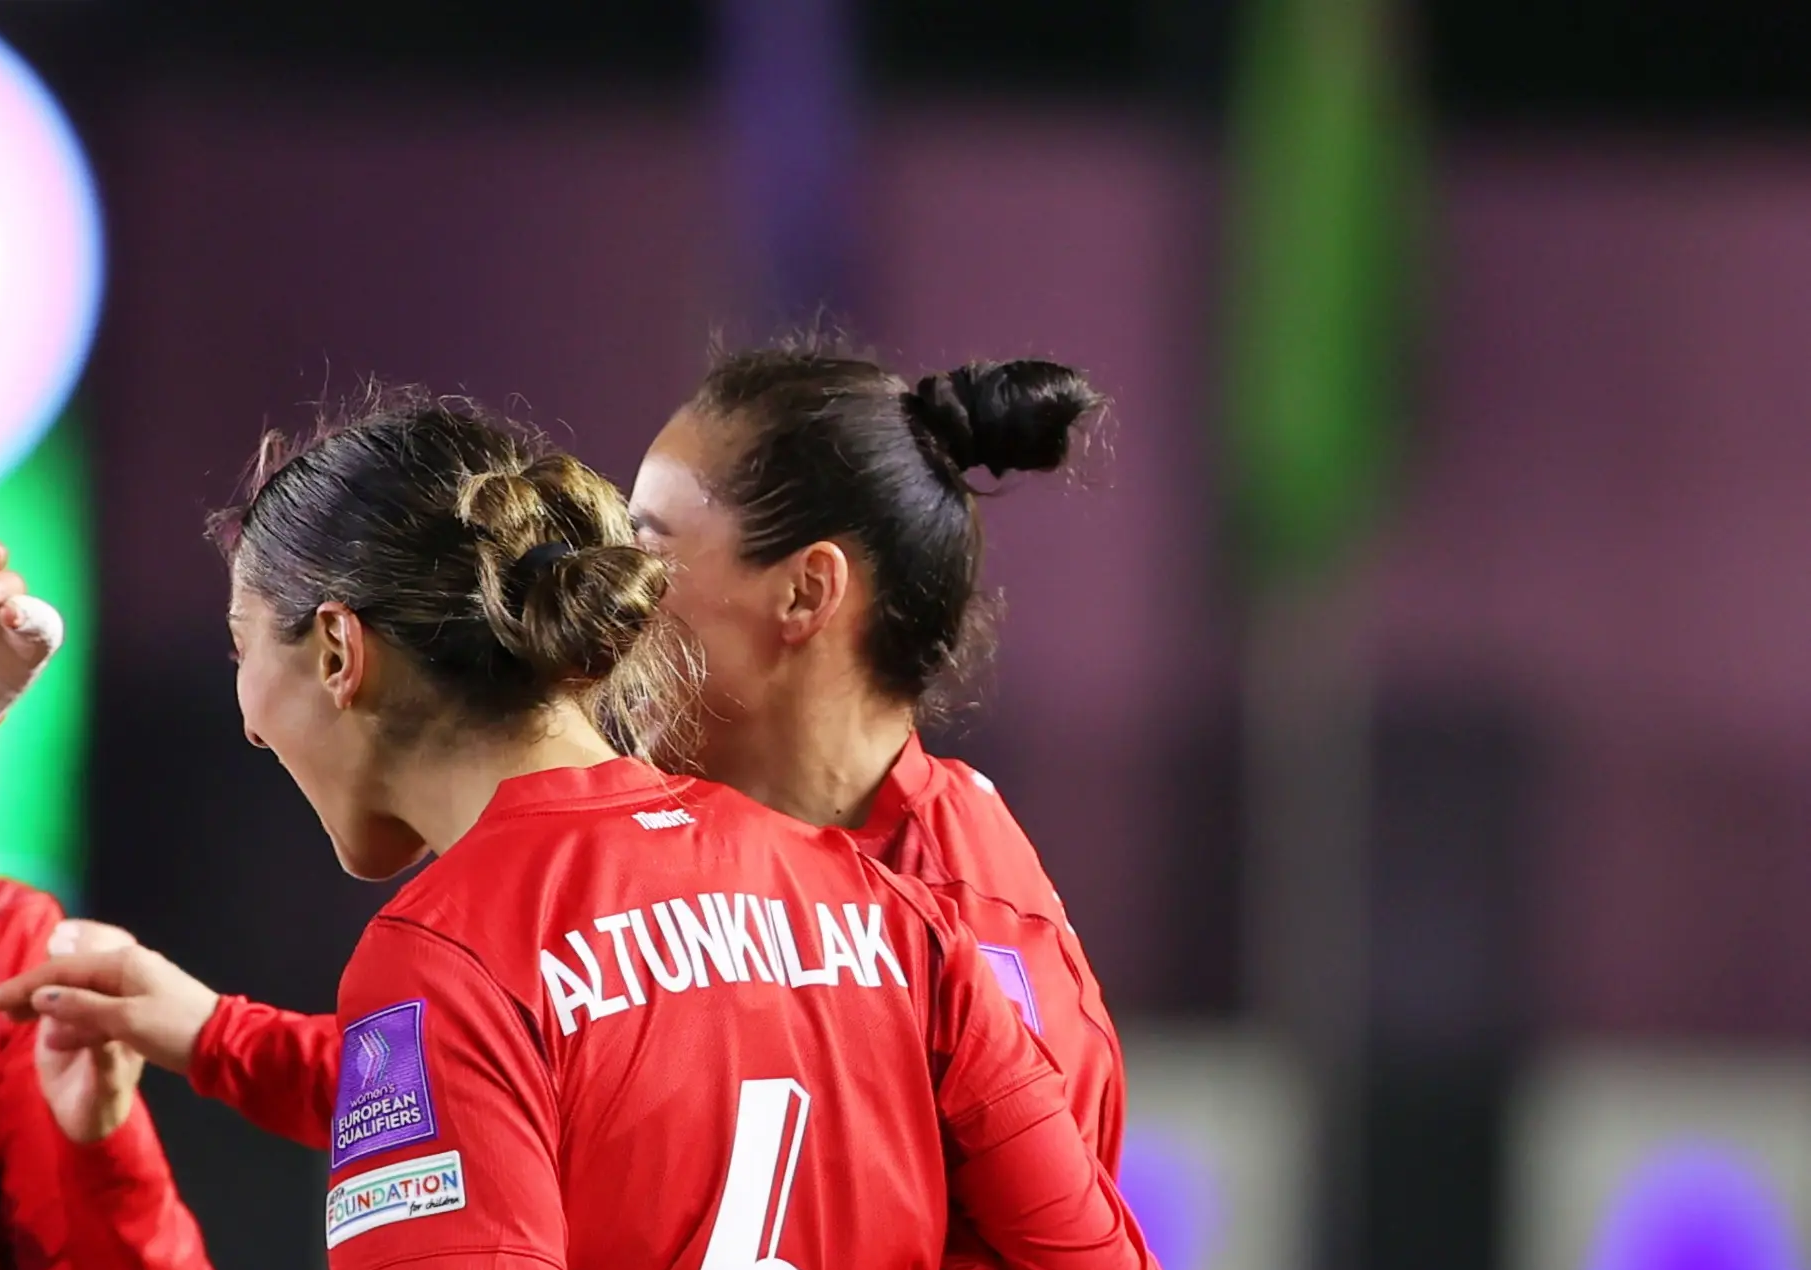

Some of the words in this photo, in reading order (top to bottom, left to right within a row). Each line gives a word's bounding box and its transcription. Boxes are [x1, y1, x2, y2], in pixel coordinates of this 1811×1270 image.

[540, 893, 909, 1037] ALTUNKILAK
[337, 1107, 421, 1149] QUALIFIERS
[338, 1090, 417, 1132] EUROPEAN
[409, 1201, 423, 1217] for
[426, 1196, 460, 1210] children
